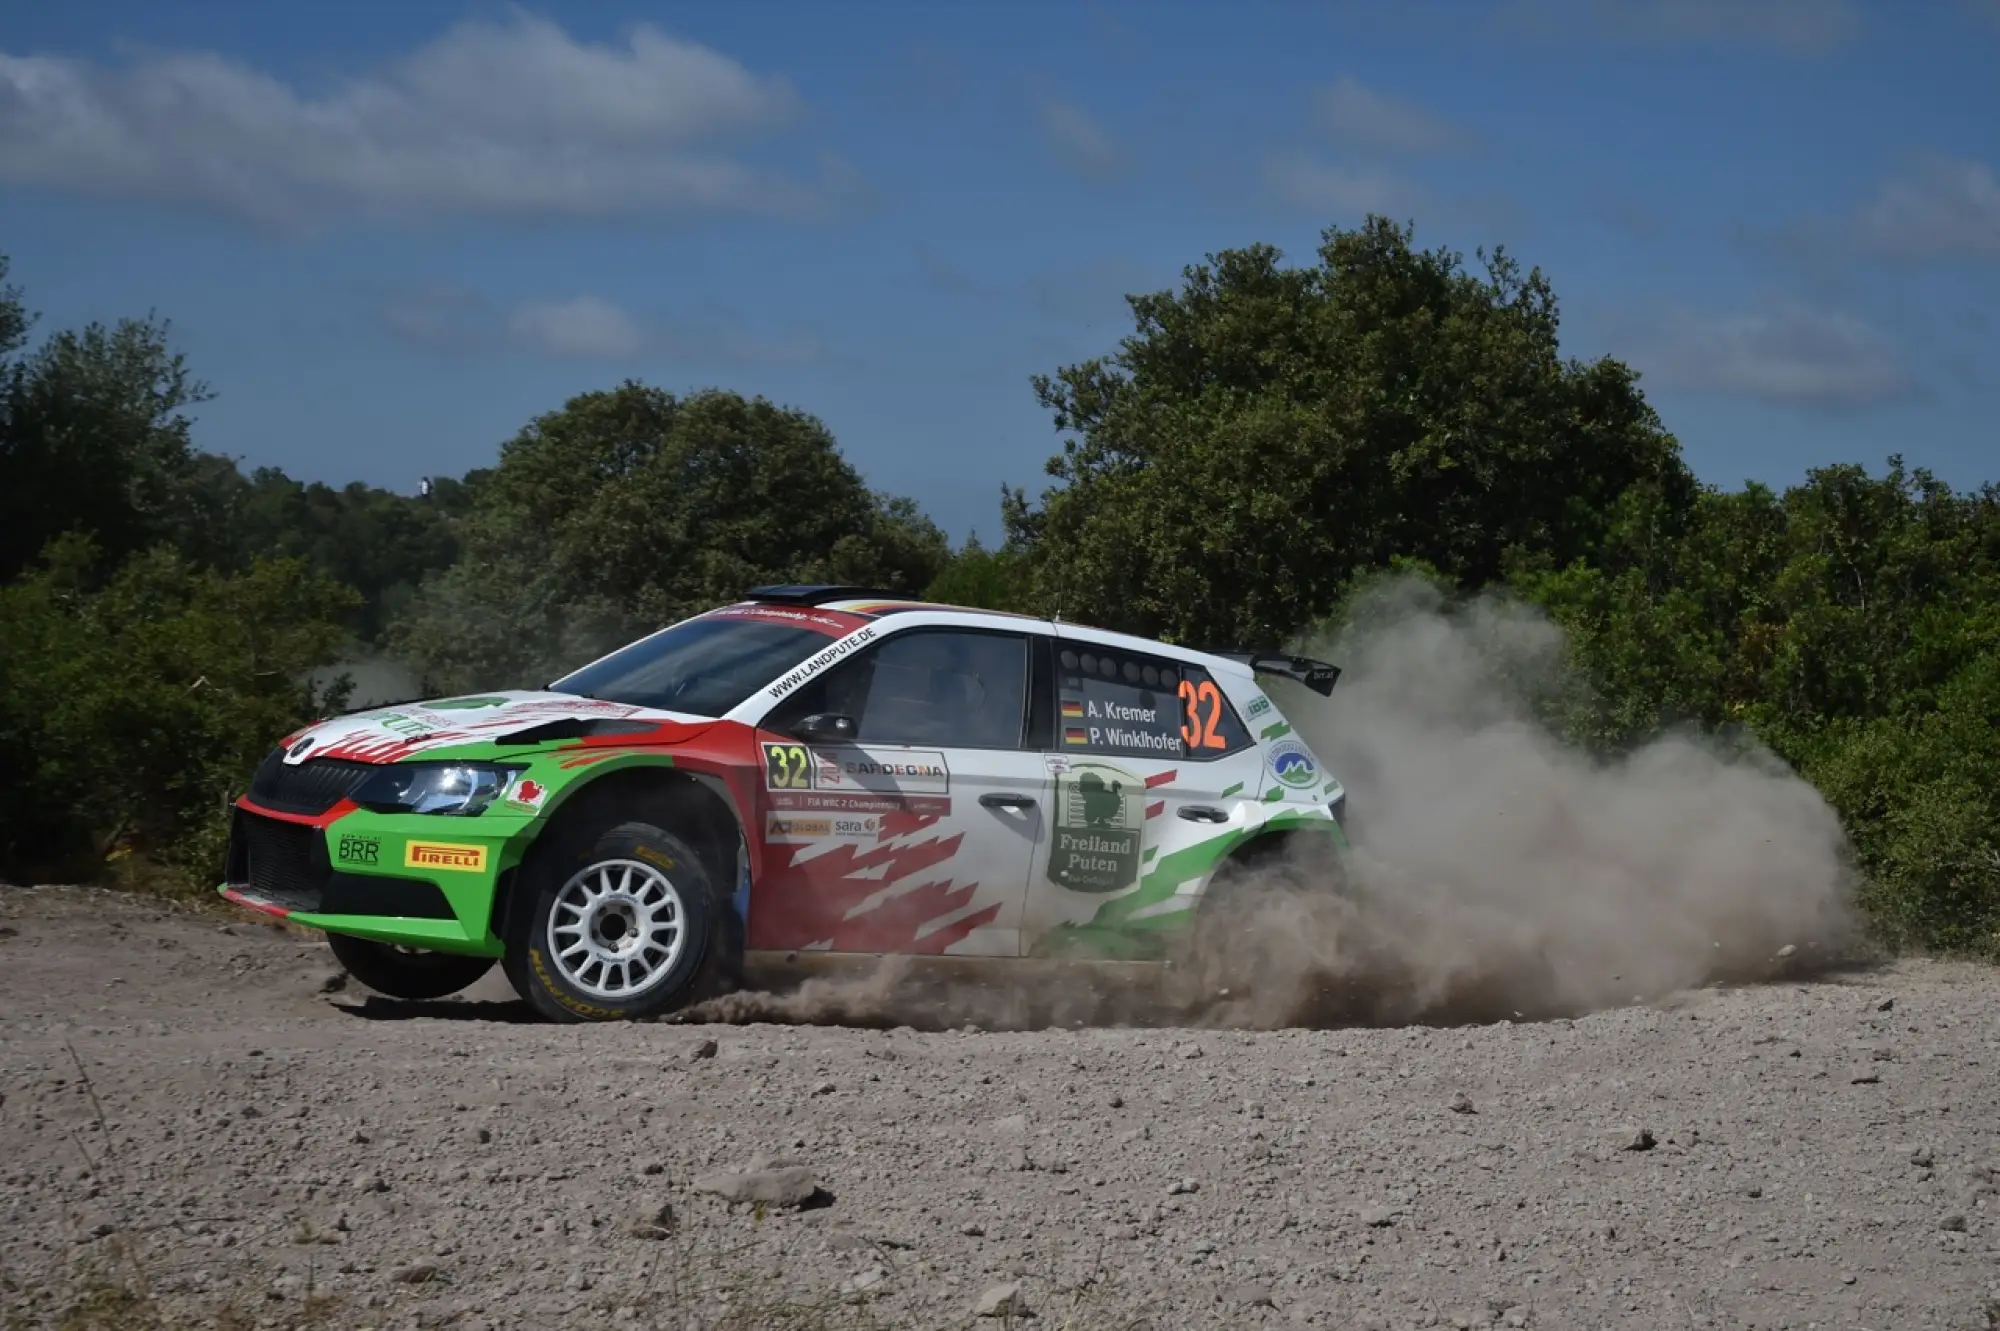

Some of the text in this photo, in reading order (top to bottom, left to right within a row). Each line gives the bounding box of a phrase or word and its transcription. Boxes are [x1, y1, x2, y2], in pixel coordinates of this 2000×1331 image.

[768, 627, 877, 698] WWW.LANDPUTE.DE
[1087, 700, 1156, 723] A. Kremer
[1178, 680, 1226, 749] 32
[1089, 727, 1181, 751] P. Winklhofer
[771, 746, 808, 788] 32
[845, 763, 943, 777] SARDEGNA
[807, 798, 820, 807] FIA
[822, 799, 839, 807] WRC
[841, 799, 846, 808] 2
[835, 821, 862, 832] sara
[339, 839, 379, 863] BRR
[1060, 834, 1131, 854] Freiland
[412, 845, 480, 866] PIRELLI
[1068, 854, 1117, 872] Puten
